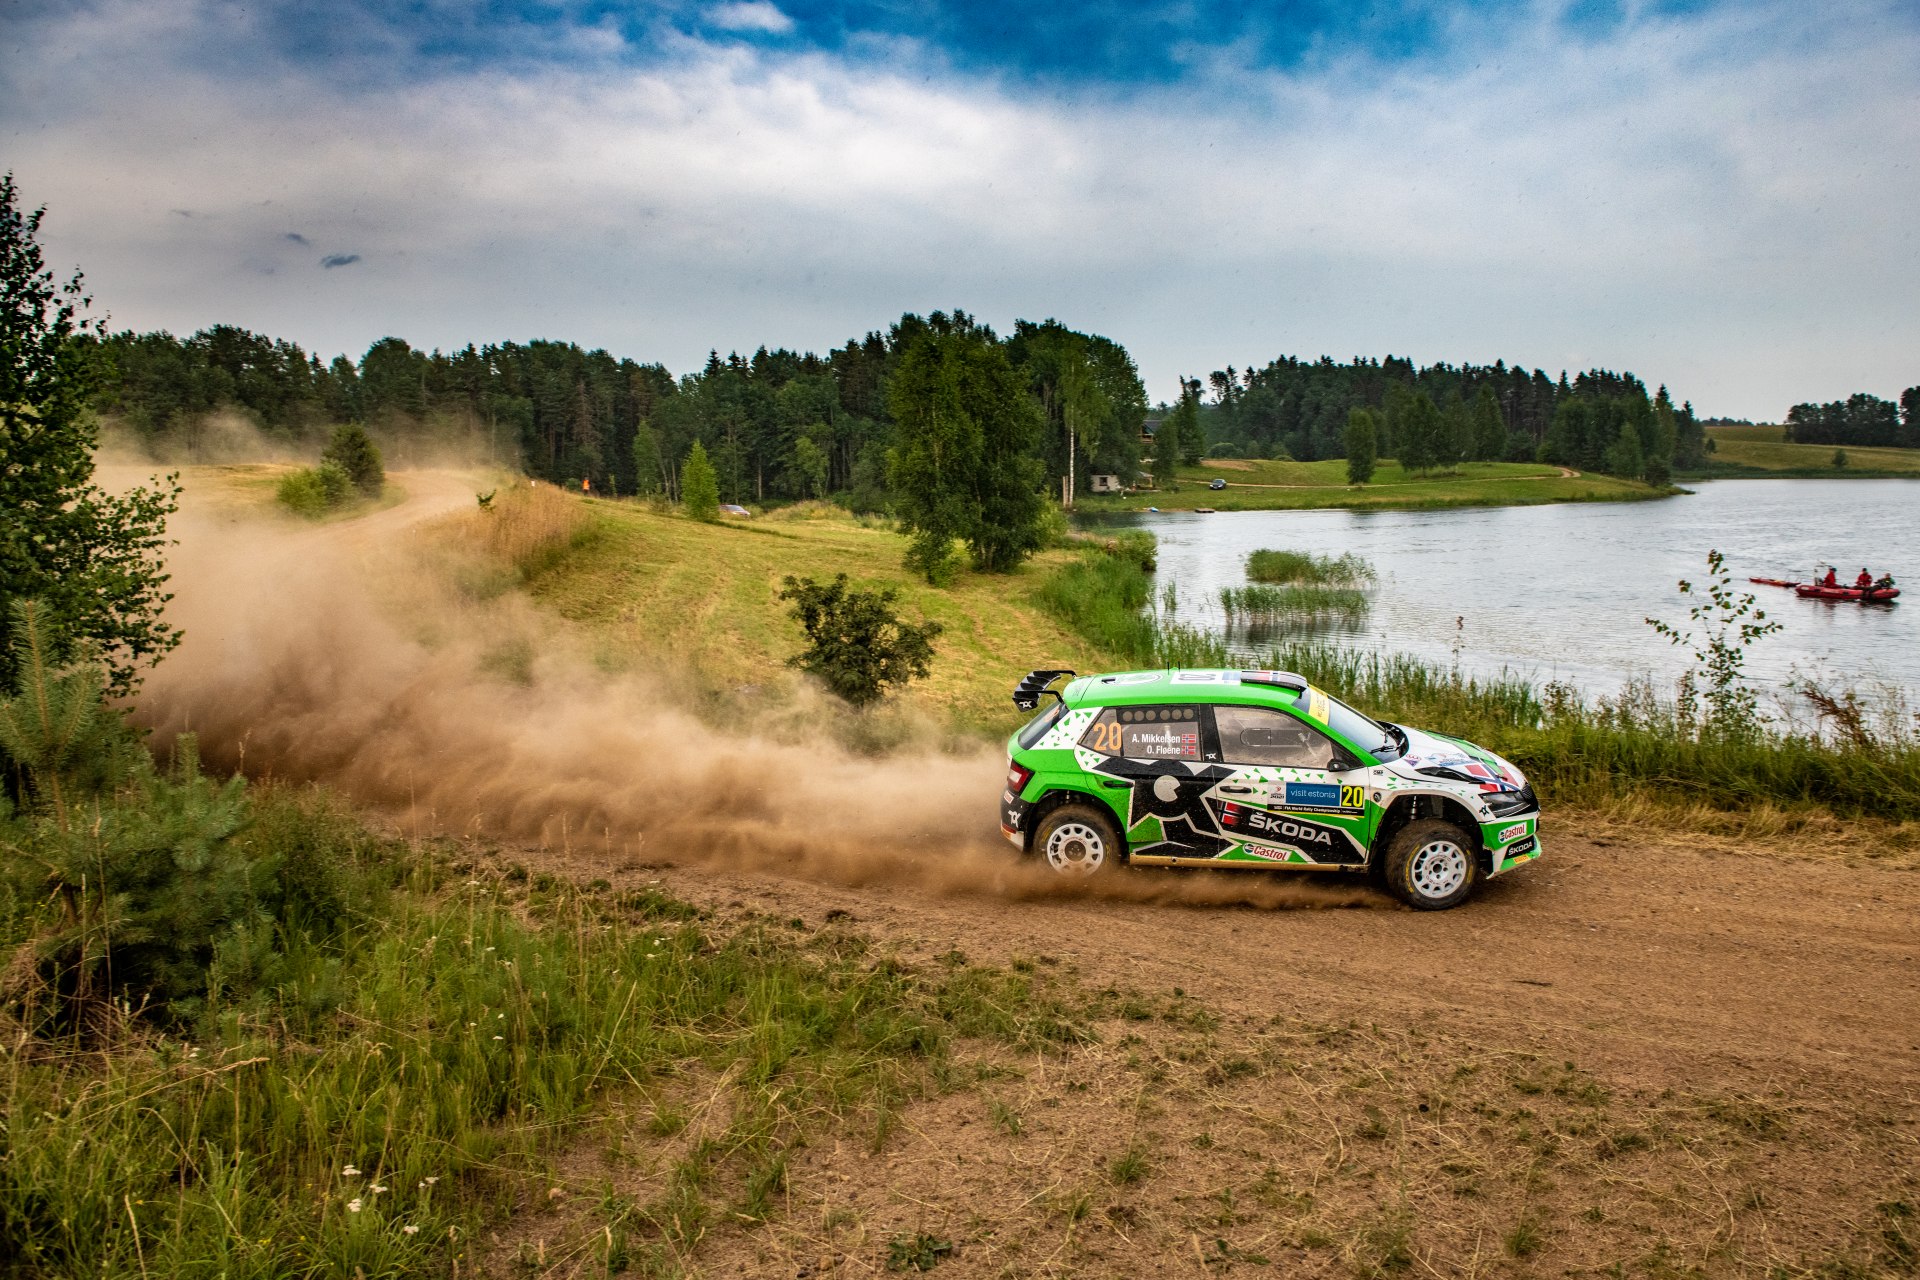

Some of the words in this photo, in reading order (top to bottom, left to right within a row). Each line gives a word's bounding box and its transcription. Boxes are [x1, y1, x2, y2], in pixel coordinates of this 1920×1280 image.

[1093, 722, 1122, 751] 20
[1132, 734, 1139, 743] A.
[1141, 733, 1180, 744] Mikkelsen
[1290, 788, 1307, 797] visit
[1307, 790, 1336, 799] estonia
[1341, 785, 1363, 808] 20
[1248, 811, 1332, 846] ŠKODA
[1504, 824, 1525, 840] Castrol
[1253, 845, 1288, 861] Castrol
